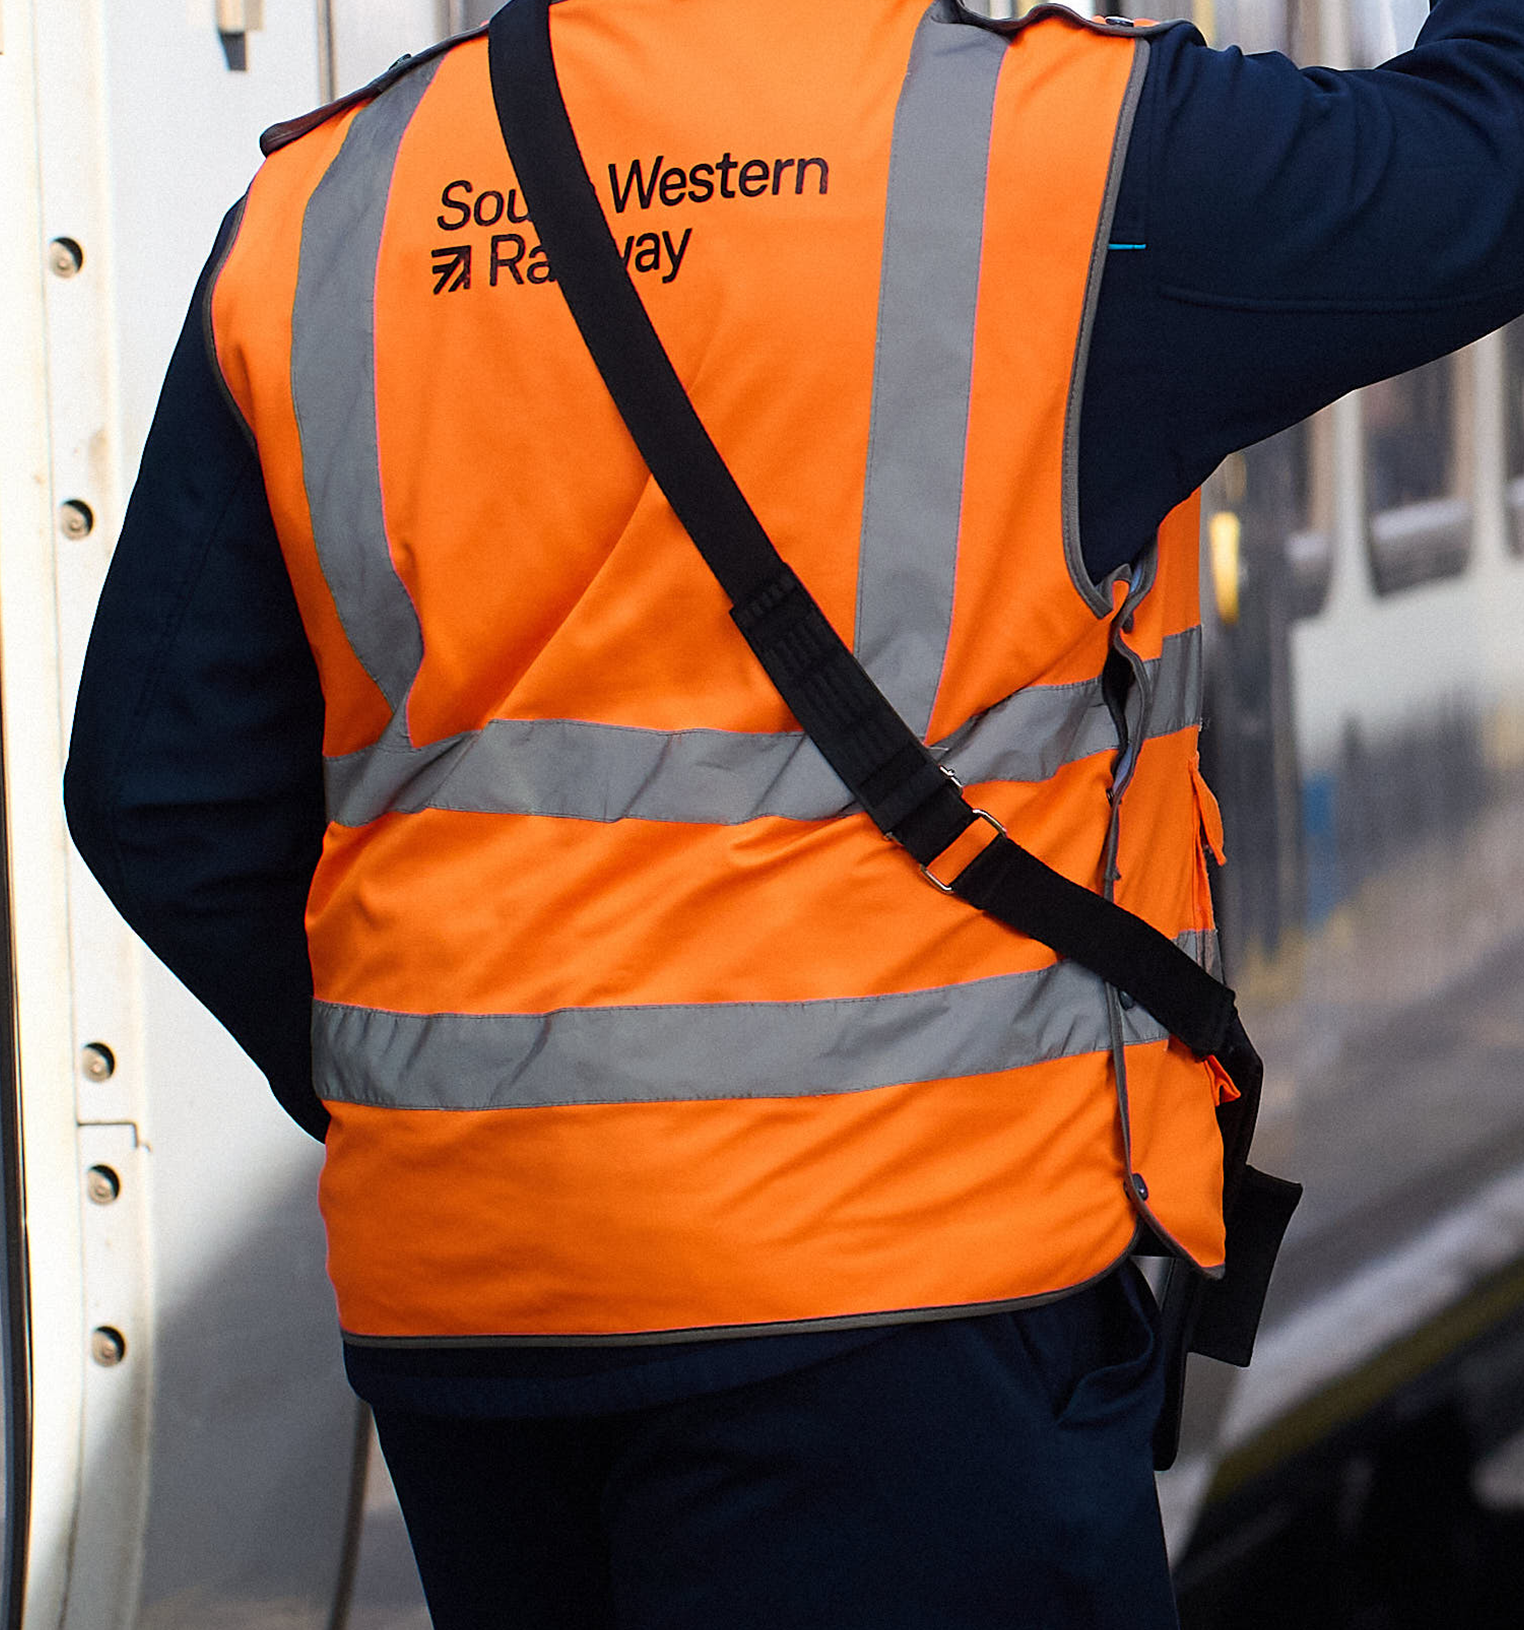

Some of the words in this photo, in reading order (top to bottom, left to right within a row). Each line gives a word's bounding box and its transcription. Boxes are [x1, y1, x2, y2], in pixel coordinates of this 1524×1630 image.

[437, 178, 541, 231] Sou
[608, 153, 829, 214] Western
[489, 227, 693, 287] Raay
